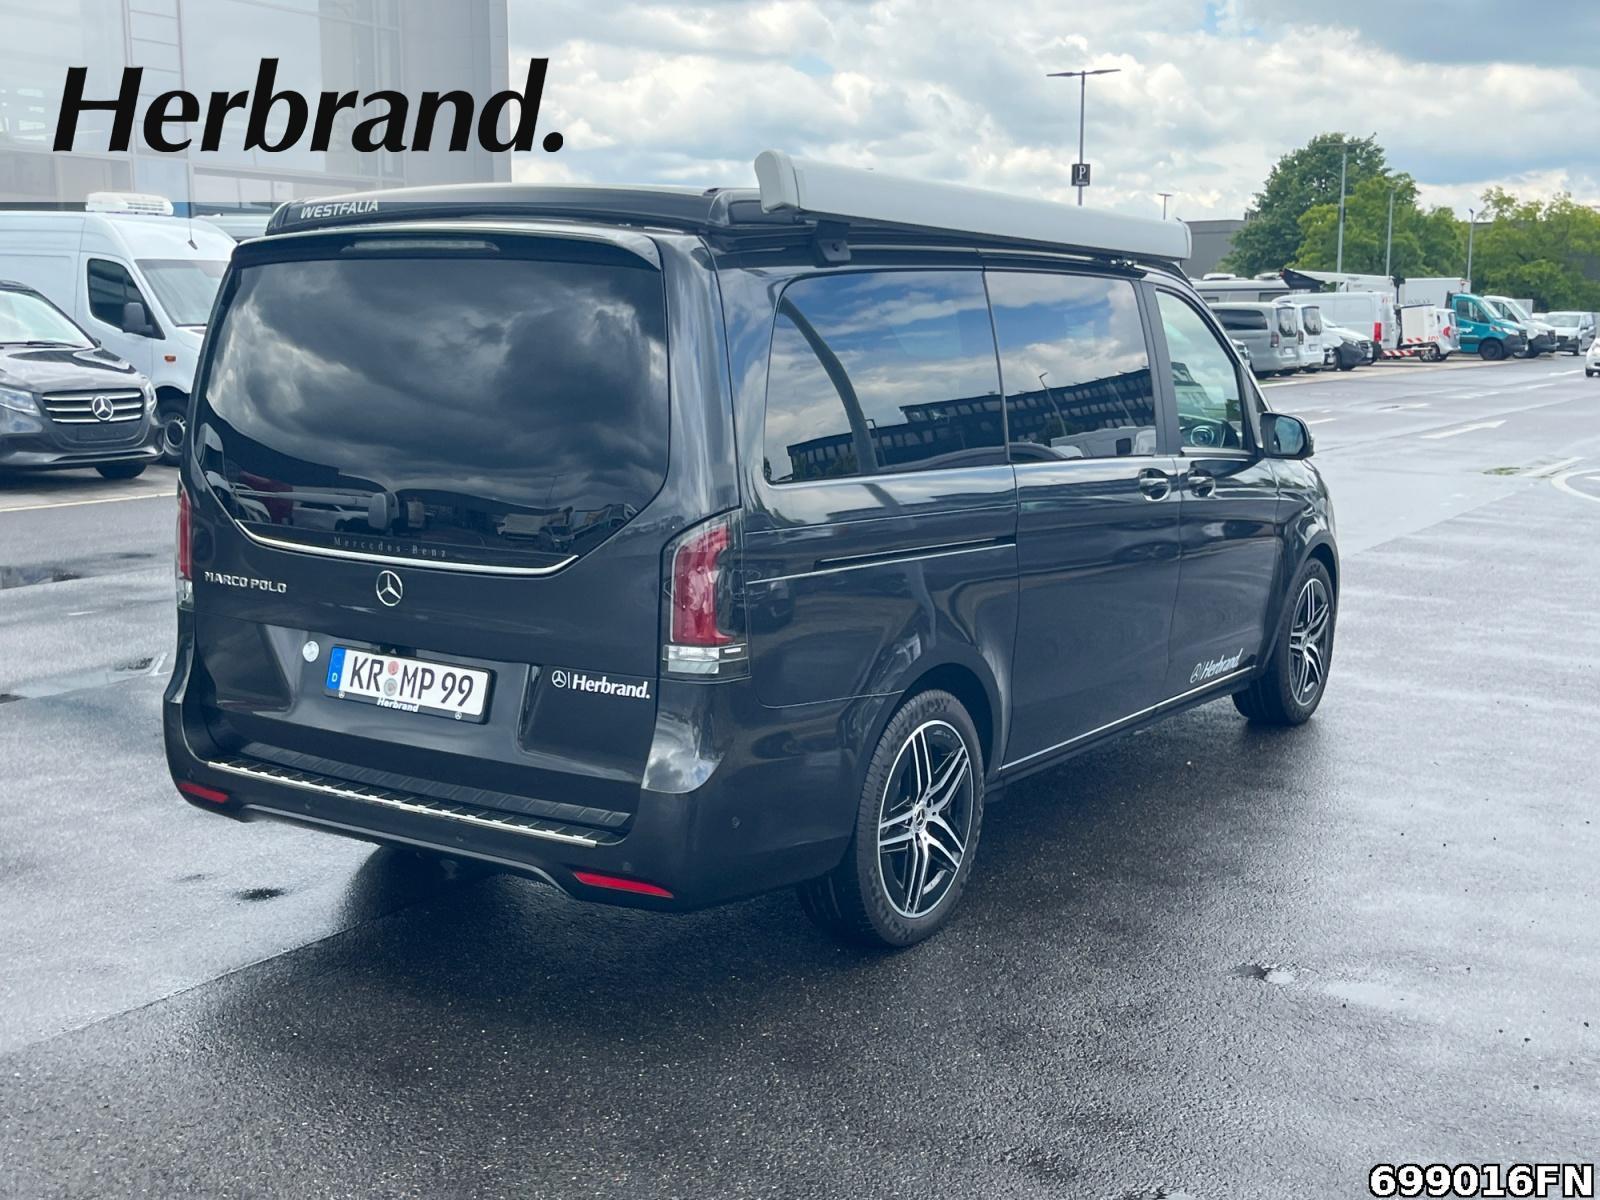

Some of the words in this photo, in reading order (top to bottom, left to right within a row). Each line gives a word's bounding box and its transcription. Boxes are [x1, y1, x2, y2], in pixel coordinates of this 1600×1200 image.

[1079, 165, 1086, 179] P
[300, 199, 379, 219] WESTFALIA
[333, 536, 447, 558] Mercedes-Benz
[204, 571, 249, 588] MARCO
[250, 578, 288, 594] POLO
[349, 656, 385, 692] KR
[400, 664, 436, 700] MP
[441, 672, 475, 707] 99
[572, 673, 651, 699] Herbrand.
[377, 697, 419, 712] Herbrand
